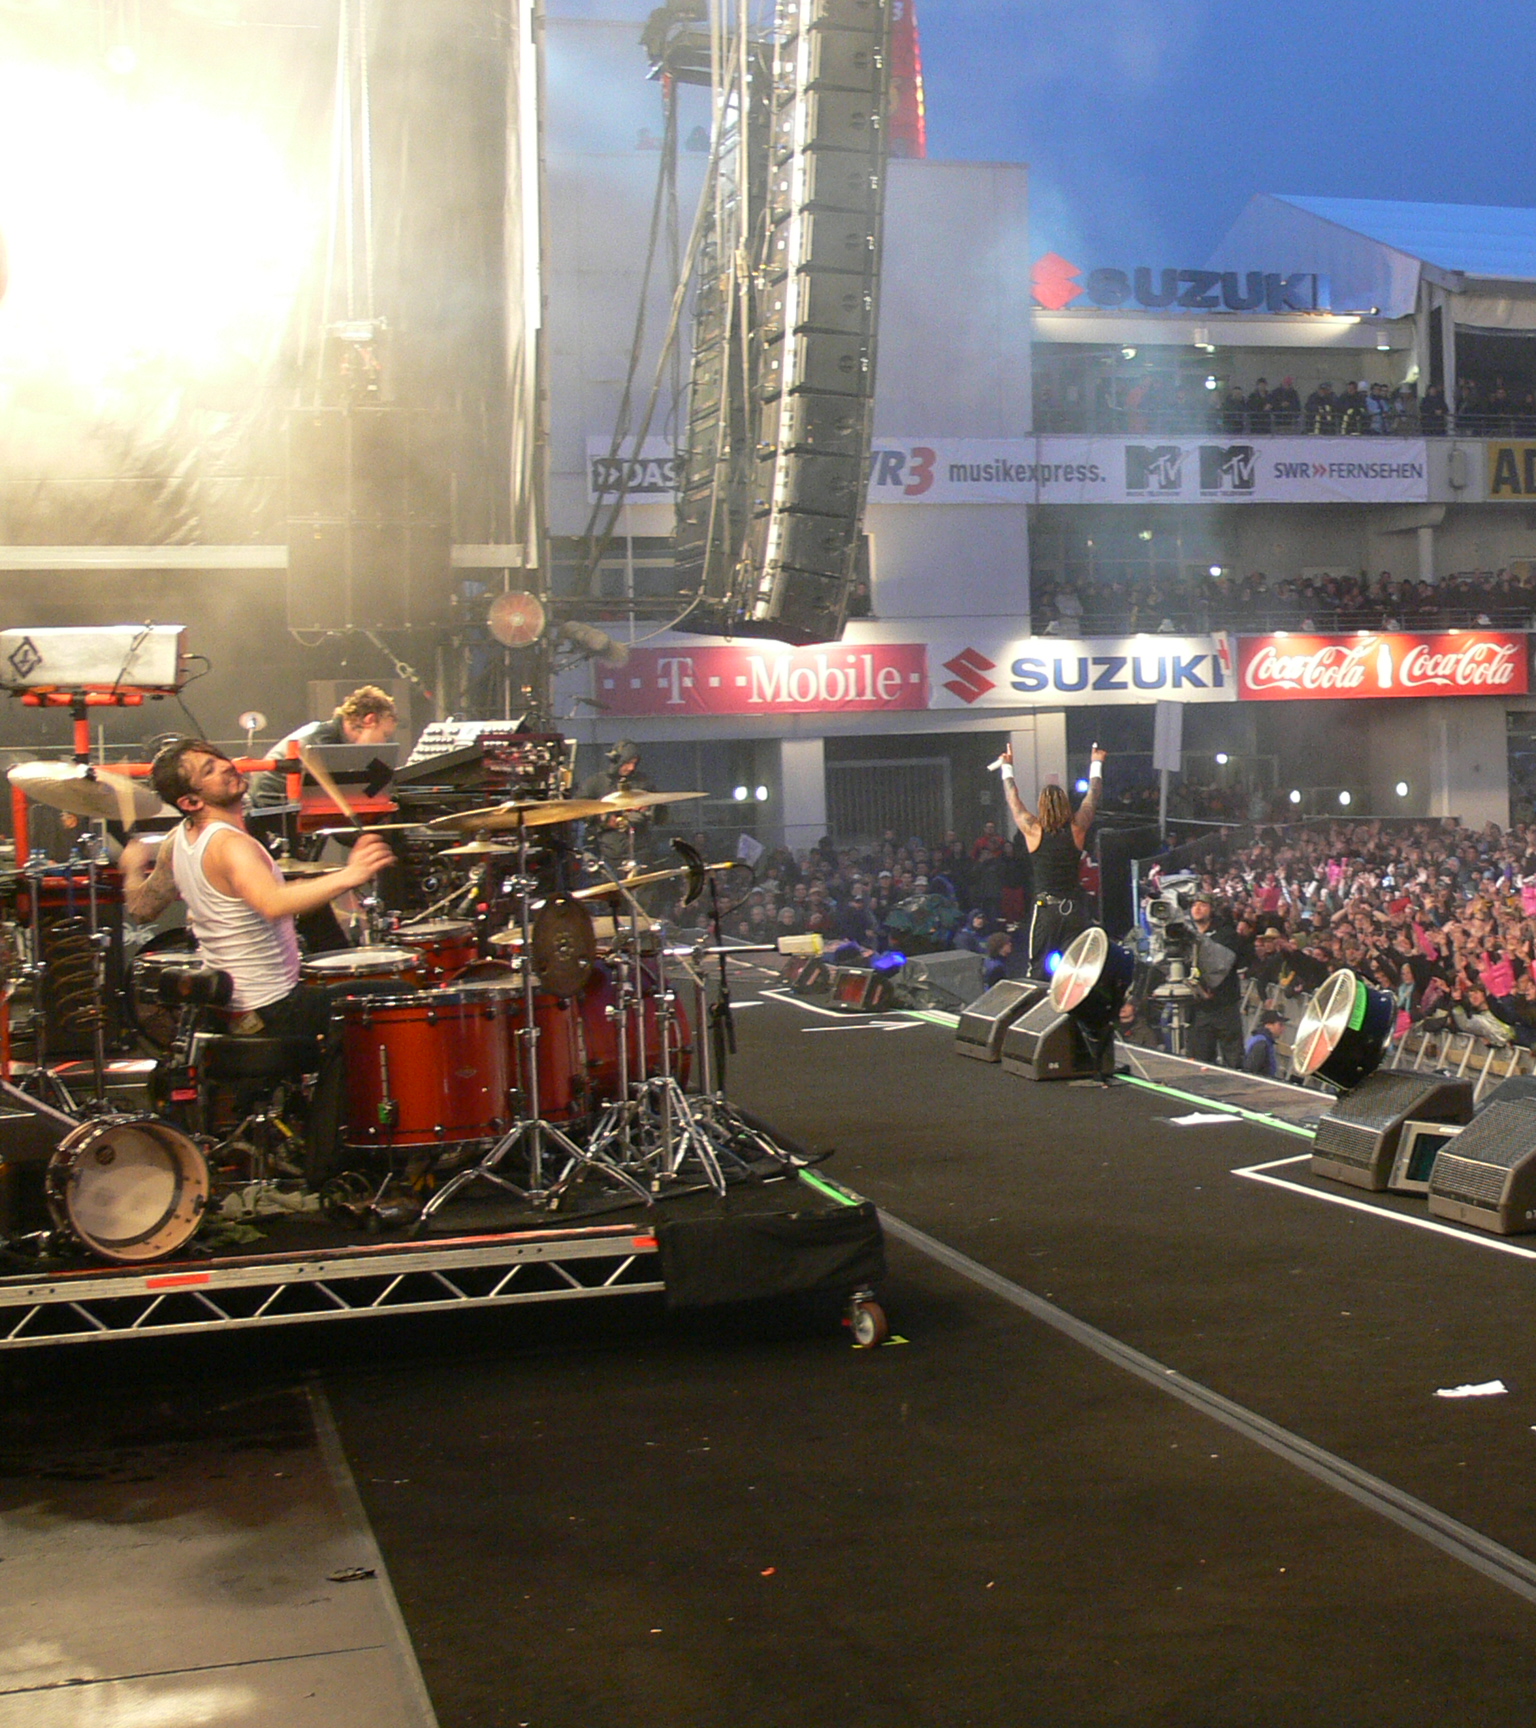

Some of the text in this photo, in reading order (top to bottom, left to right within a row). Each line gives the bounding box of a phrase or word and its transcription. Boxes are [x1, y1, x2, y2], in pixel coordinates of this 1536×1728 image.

[1199, 445, 1261, 489] MTV
[1274, 462, 1423, 479] SWR FERNSEHEN
[747, 653, 903, 703] Mobile
[1010, 654, 1225, 692] SUZUKI
